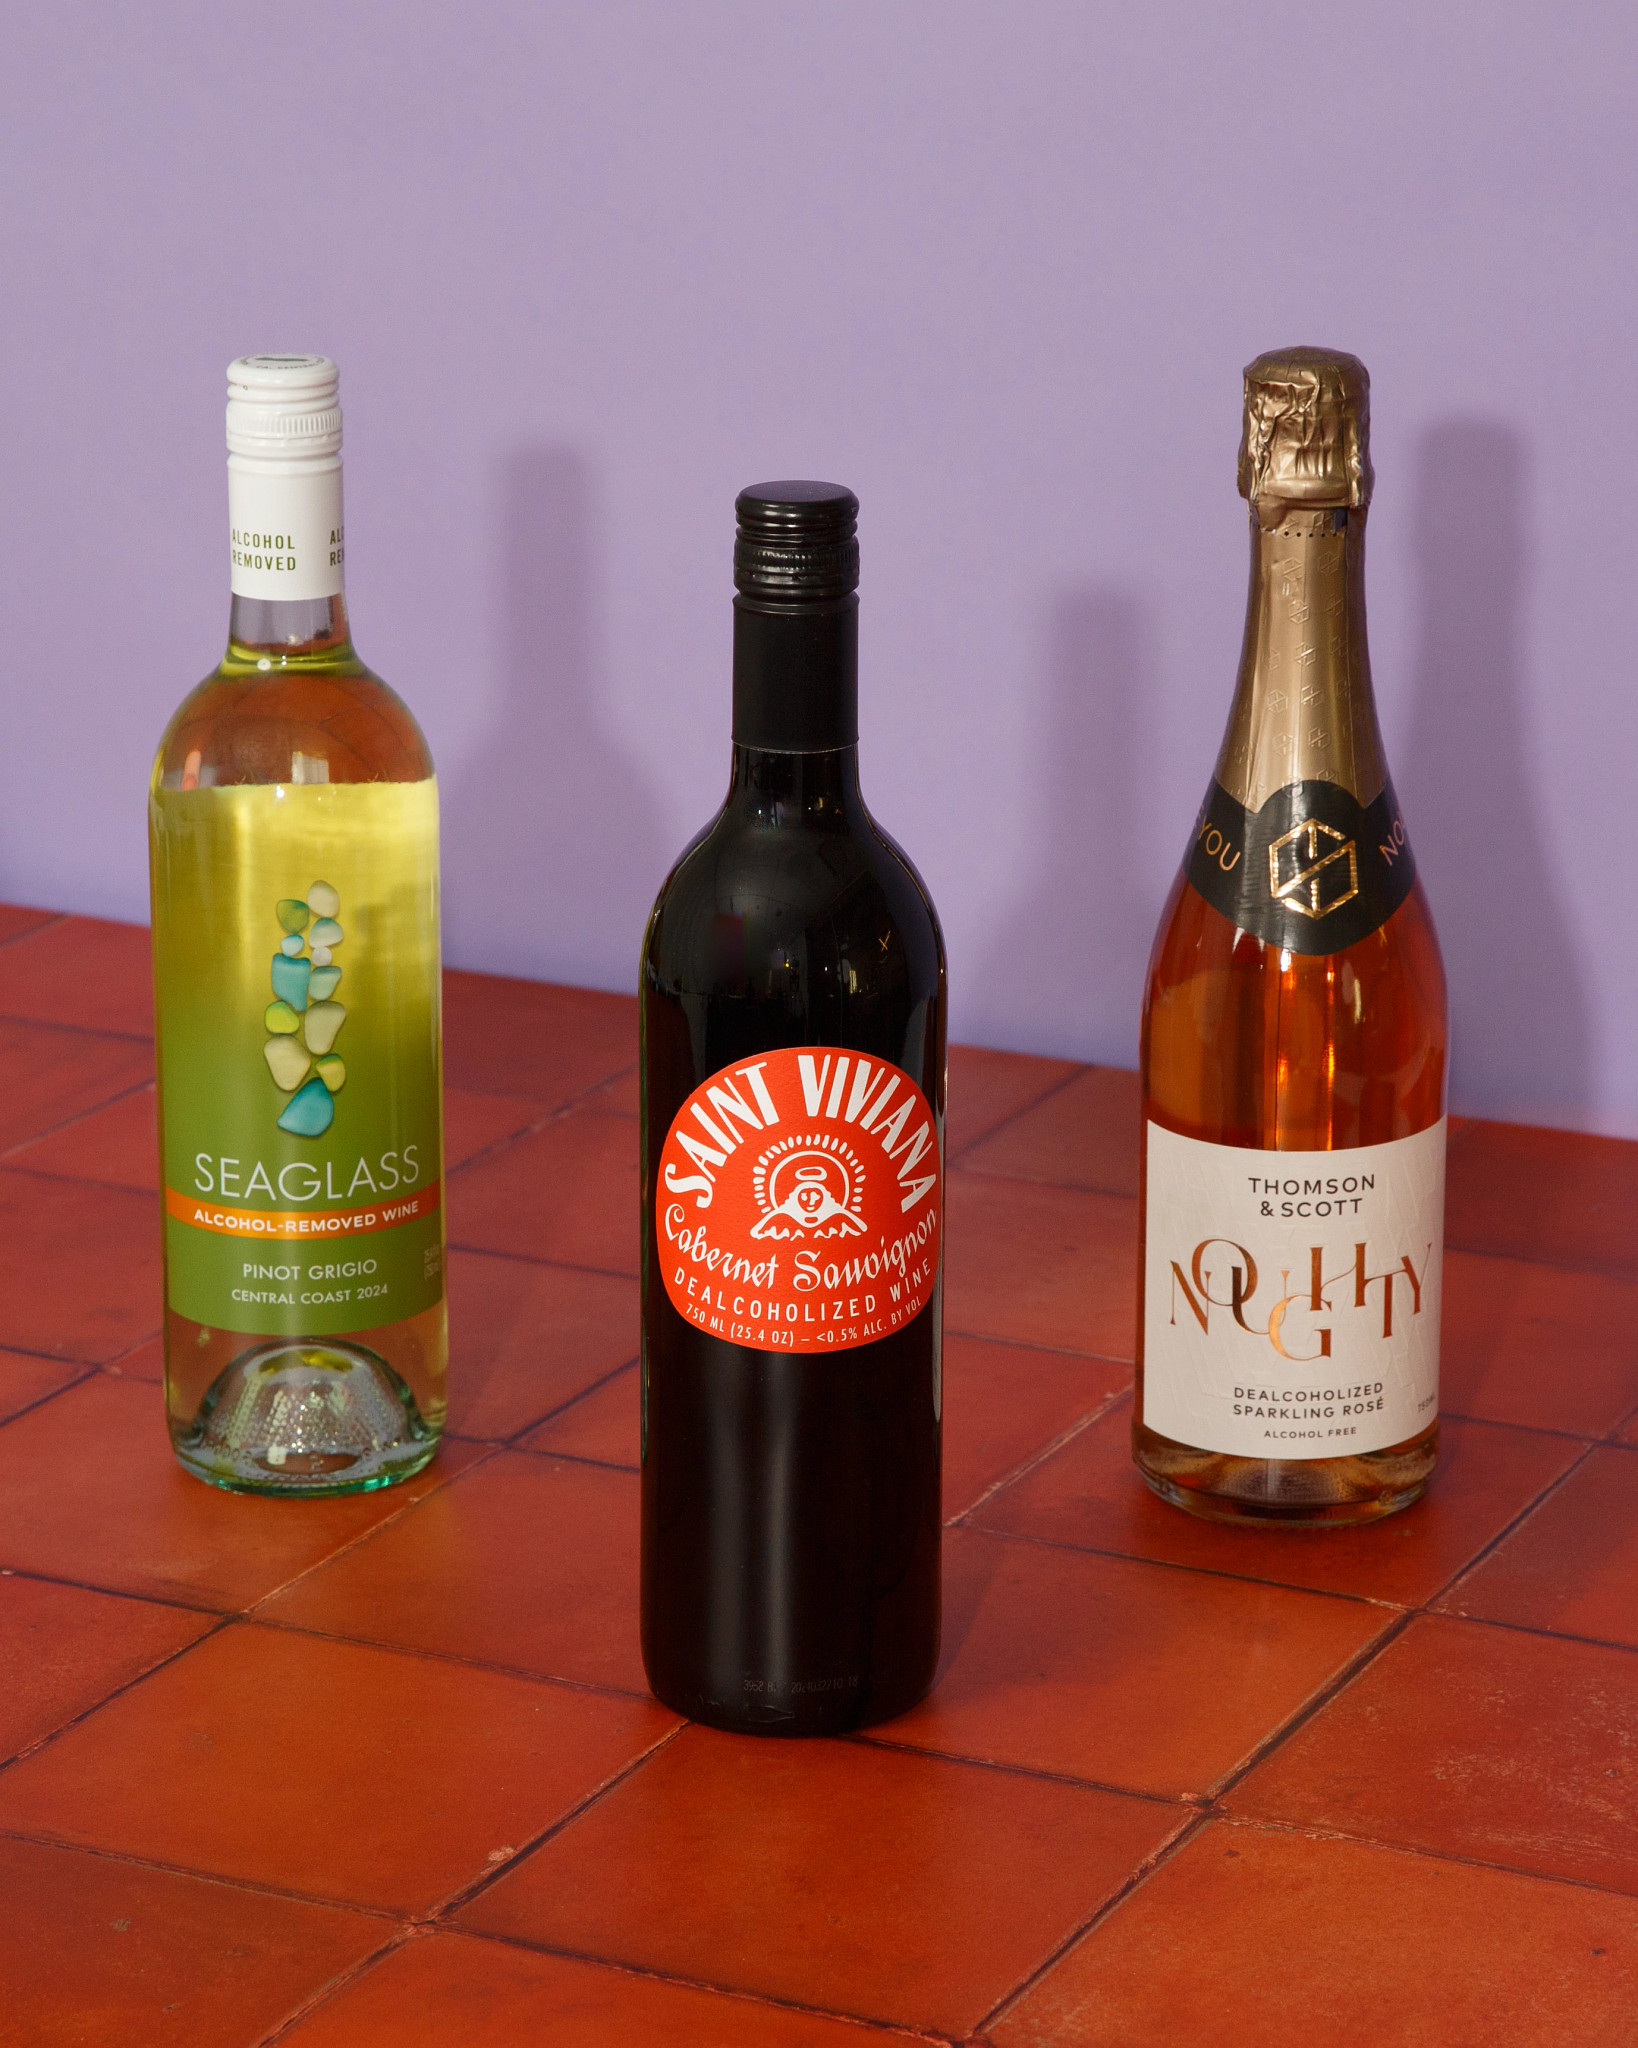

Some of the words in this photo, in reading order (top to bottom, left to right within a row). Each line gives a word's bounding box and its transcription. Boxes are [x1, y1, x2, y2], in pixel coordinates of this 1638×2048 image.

[231, 528, 296, 550] ALCOHOL
[231, 551, 297, 571] REMOVED
[1197, 815, 1241, 871] YOU
[664, 1061, 780, 1209] SAINT
[797, 1054, 937, 1214] VIVIANA
[194, 1144, 419, 1202] SEAGLASS
[1247, 1174, 1375, 1196] THOMSON
[194, 1208, 377, 1233] ALCOHOL-REMOVED
[382, 1200, 419, 1223] WINE
[664, 1202, 780, 1290] Cabernet
[792, 1207, 937, 1293] Sauvignon
[242, 1262, 301, 1281] PINOT
[308, 1258, 378, 1280] GRIGIO
[231, 1288, 296, 1305] CENTRAL
[300, 1289, 351, 1305] COAST
[356, 1283, 389, 1301] 2024
[674, 1266, 877, 1323] DEALCOHOLIZED
[888, 1257, 932, 1304] WINE
[1169, 1238, 1432, 1362] NOUGHTY
[685, 1302, 706, 1325] 750
[709, 1317, 725, 1334] ML
[730, 1321, 765, 1343] (25.4
[771, 1330, 795, 1348] OZ)
[816, 1326, 858, 1344] <0.5%
[863, 1318, 888, 1337] ALC.
[890, 1310, 903, 1326] BY
[905, 1295, 923, 1317] VOL
[1233, 1381, 1384, 1403] DEALCOHOLIZED
[1232, 1403, 1335, 1420] SPARKLING
[1342, 1395, 1385, 1417] ROSÉ
[1263, 1429, 1324, 1440] ALCOHOL
[1327, 1426, 1358, 1438] FREE
